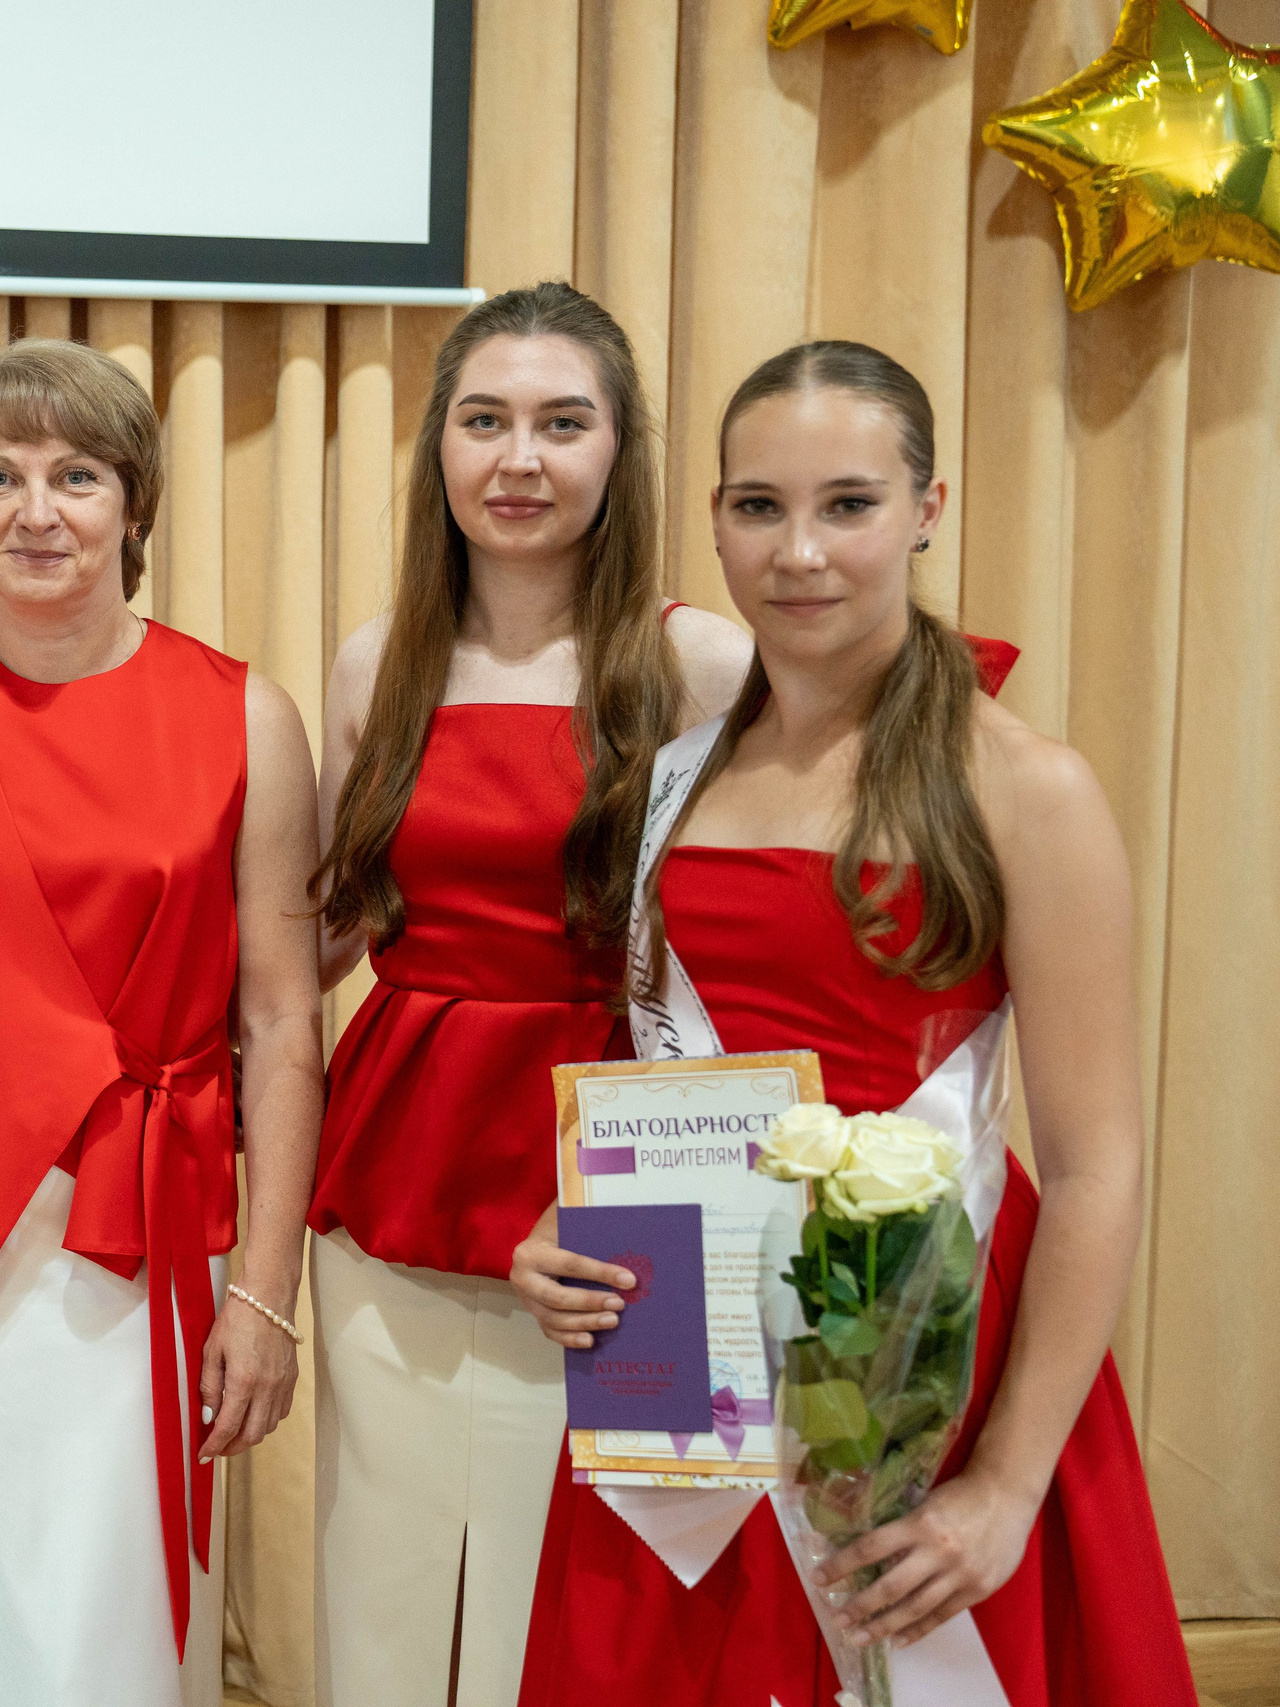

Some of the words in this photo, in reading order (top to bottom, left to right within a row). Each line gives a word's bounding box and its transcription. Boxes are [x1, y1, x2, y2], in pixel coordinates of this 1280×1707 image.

[592, 1113, 778, 1139] БЛАГОДАРНОСТ
[640, 1147, 741, 1169] РОДИТЕЛЯМ
[595, 1361, 676, 1376] АТТЕСТАТ
